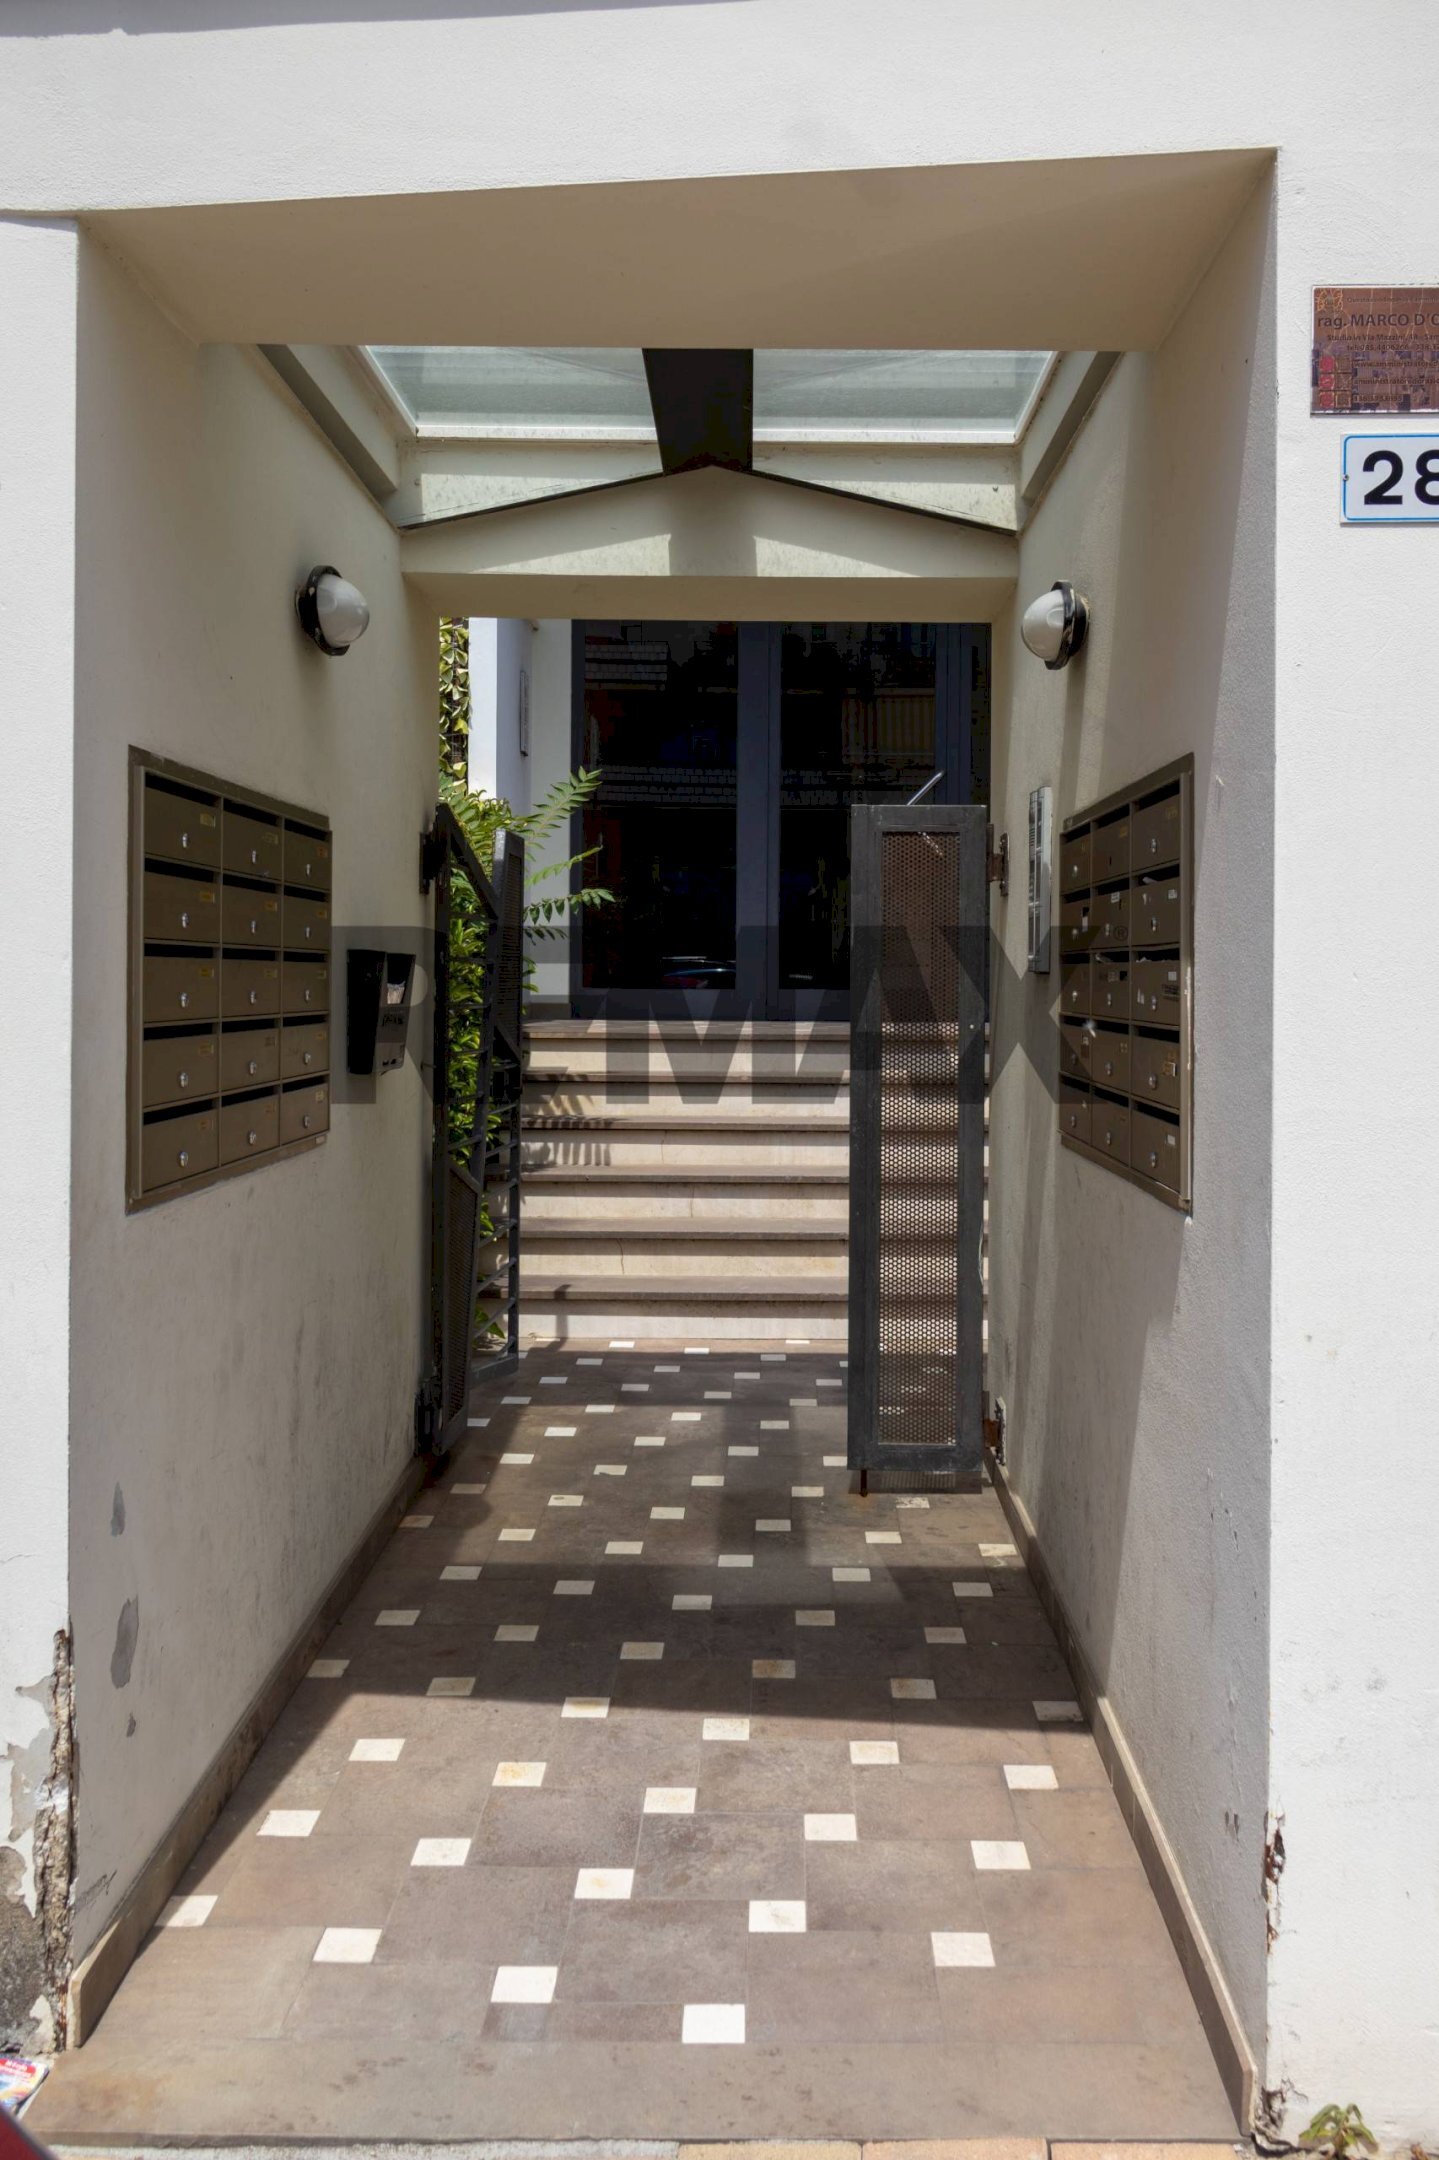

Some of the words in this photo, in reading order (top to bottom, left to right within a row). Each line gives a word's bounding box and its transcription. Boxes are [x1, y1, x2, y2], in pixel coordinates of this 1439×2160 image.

[1318, 316, 1347, 330] rag.
[1350, 313, 1409, 326] MARCO
[1362, 449, 1439, 506] 28
